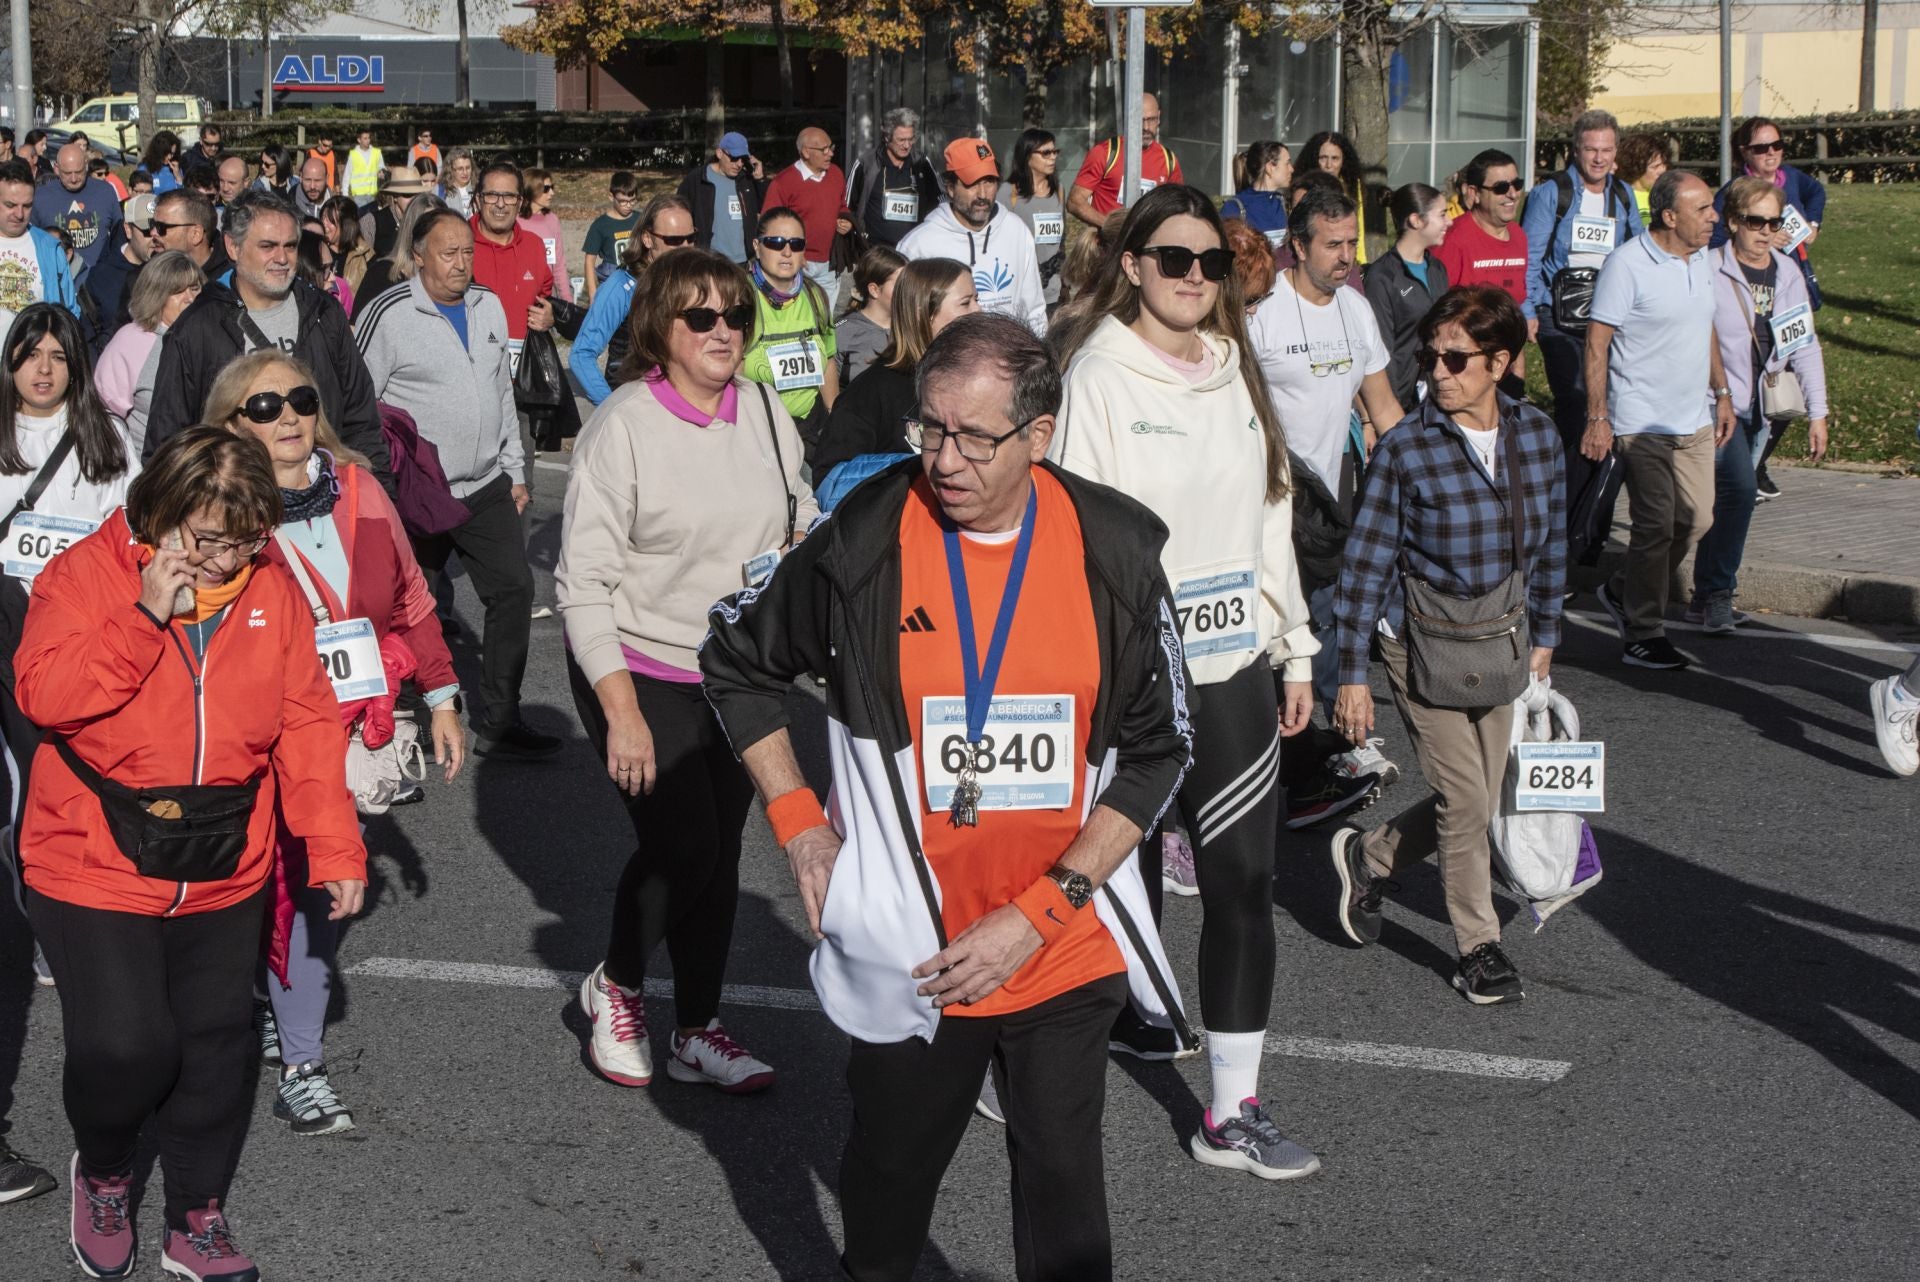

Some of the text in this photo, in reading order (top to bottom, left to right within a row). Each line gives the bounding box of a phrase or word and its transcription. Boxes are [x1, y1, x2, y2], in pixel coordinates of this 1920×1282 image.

[273, 55, 384, 84] ALDI
[891, 203, 914, 215] 4541
[1039, 223, 1061, 236] 2043
[1577, 226, 1609, 242] 6297
[1473, 259, 1504, 268] MOVING
[1781, 319, 1806, 344] 4763
[1179, 583, 1210, 594] MARCHA
[1177, 596, 1245, 636] 7603
[1161, 627, 1183, 685] COMFORT
[998, 702, 1053, 714] BENÉFICA
[940, 733, 1055, 774] 6840
[1529, 765, 1594, 790] 6284
[1019, 792, 1045, 800] SEGOVIA
